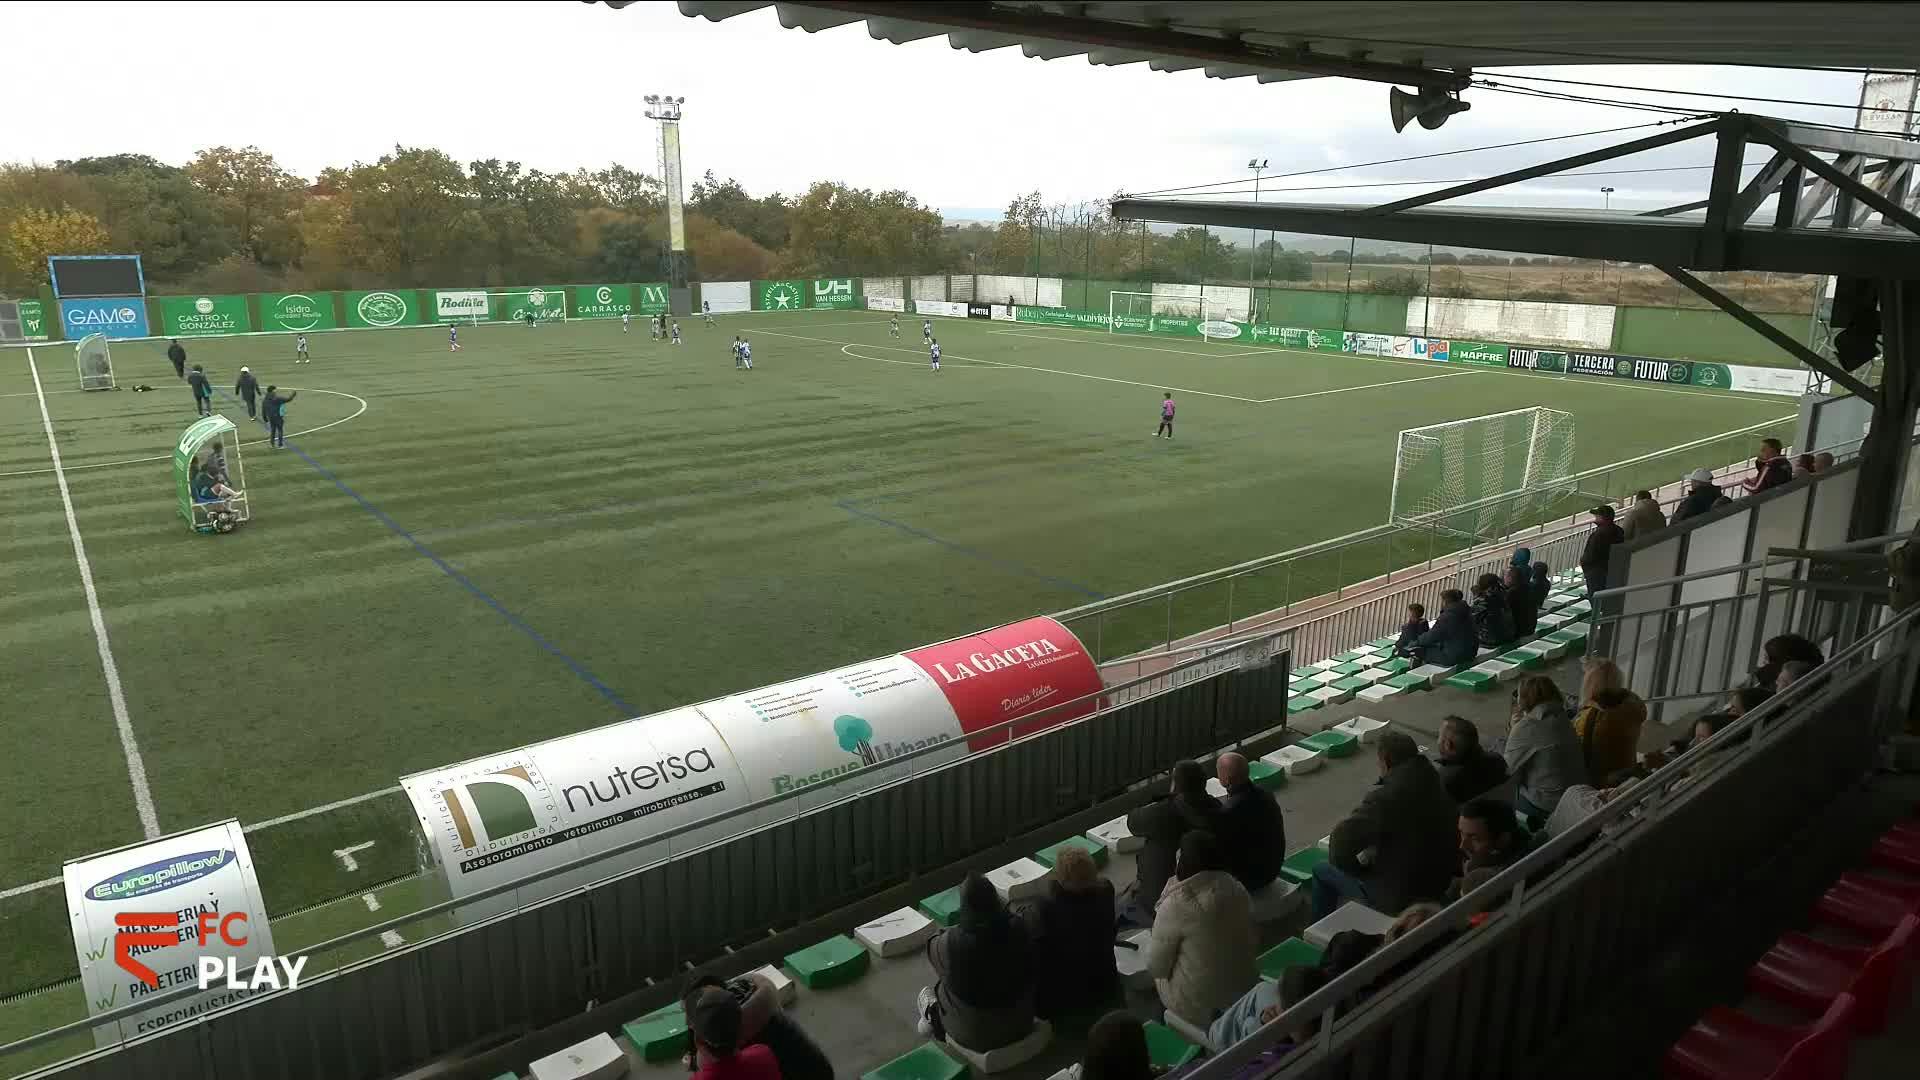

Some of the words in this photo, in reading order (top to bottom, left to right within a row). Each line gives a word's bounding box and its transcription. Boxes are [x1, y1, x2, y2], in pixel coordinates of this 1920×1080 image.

[68, 308, 136, 324] GAMO
[285, 305, 310, 313] Isidro
[578, 304, 631, 312] CARRASCO
[1414, 339, 1448, 359] lupa
[1460, 351, 1503, 361] MAPFRE
[1509, 349, 1538, 368] FUTUR
[1574, 354, 1614, 370] TERCERA
[1572, 367, 1614, 376] FEDERACIÓN
[1634, 360, 1669, 381] FUTUR
[932, 661, 978, 684] LA
[970, 638, 1061, 673] GACETA
[1001, 693, 1031, 711] Diario
[561, 747, 715, 813] nutersa
[464, 837, 553, 872] Asesoramiento
[563, 813, 624, 840] veterinario
[93, 848, 226, 898] Europillow
[210, 899, 219, 912] Y
